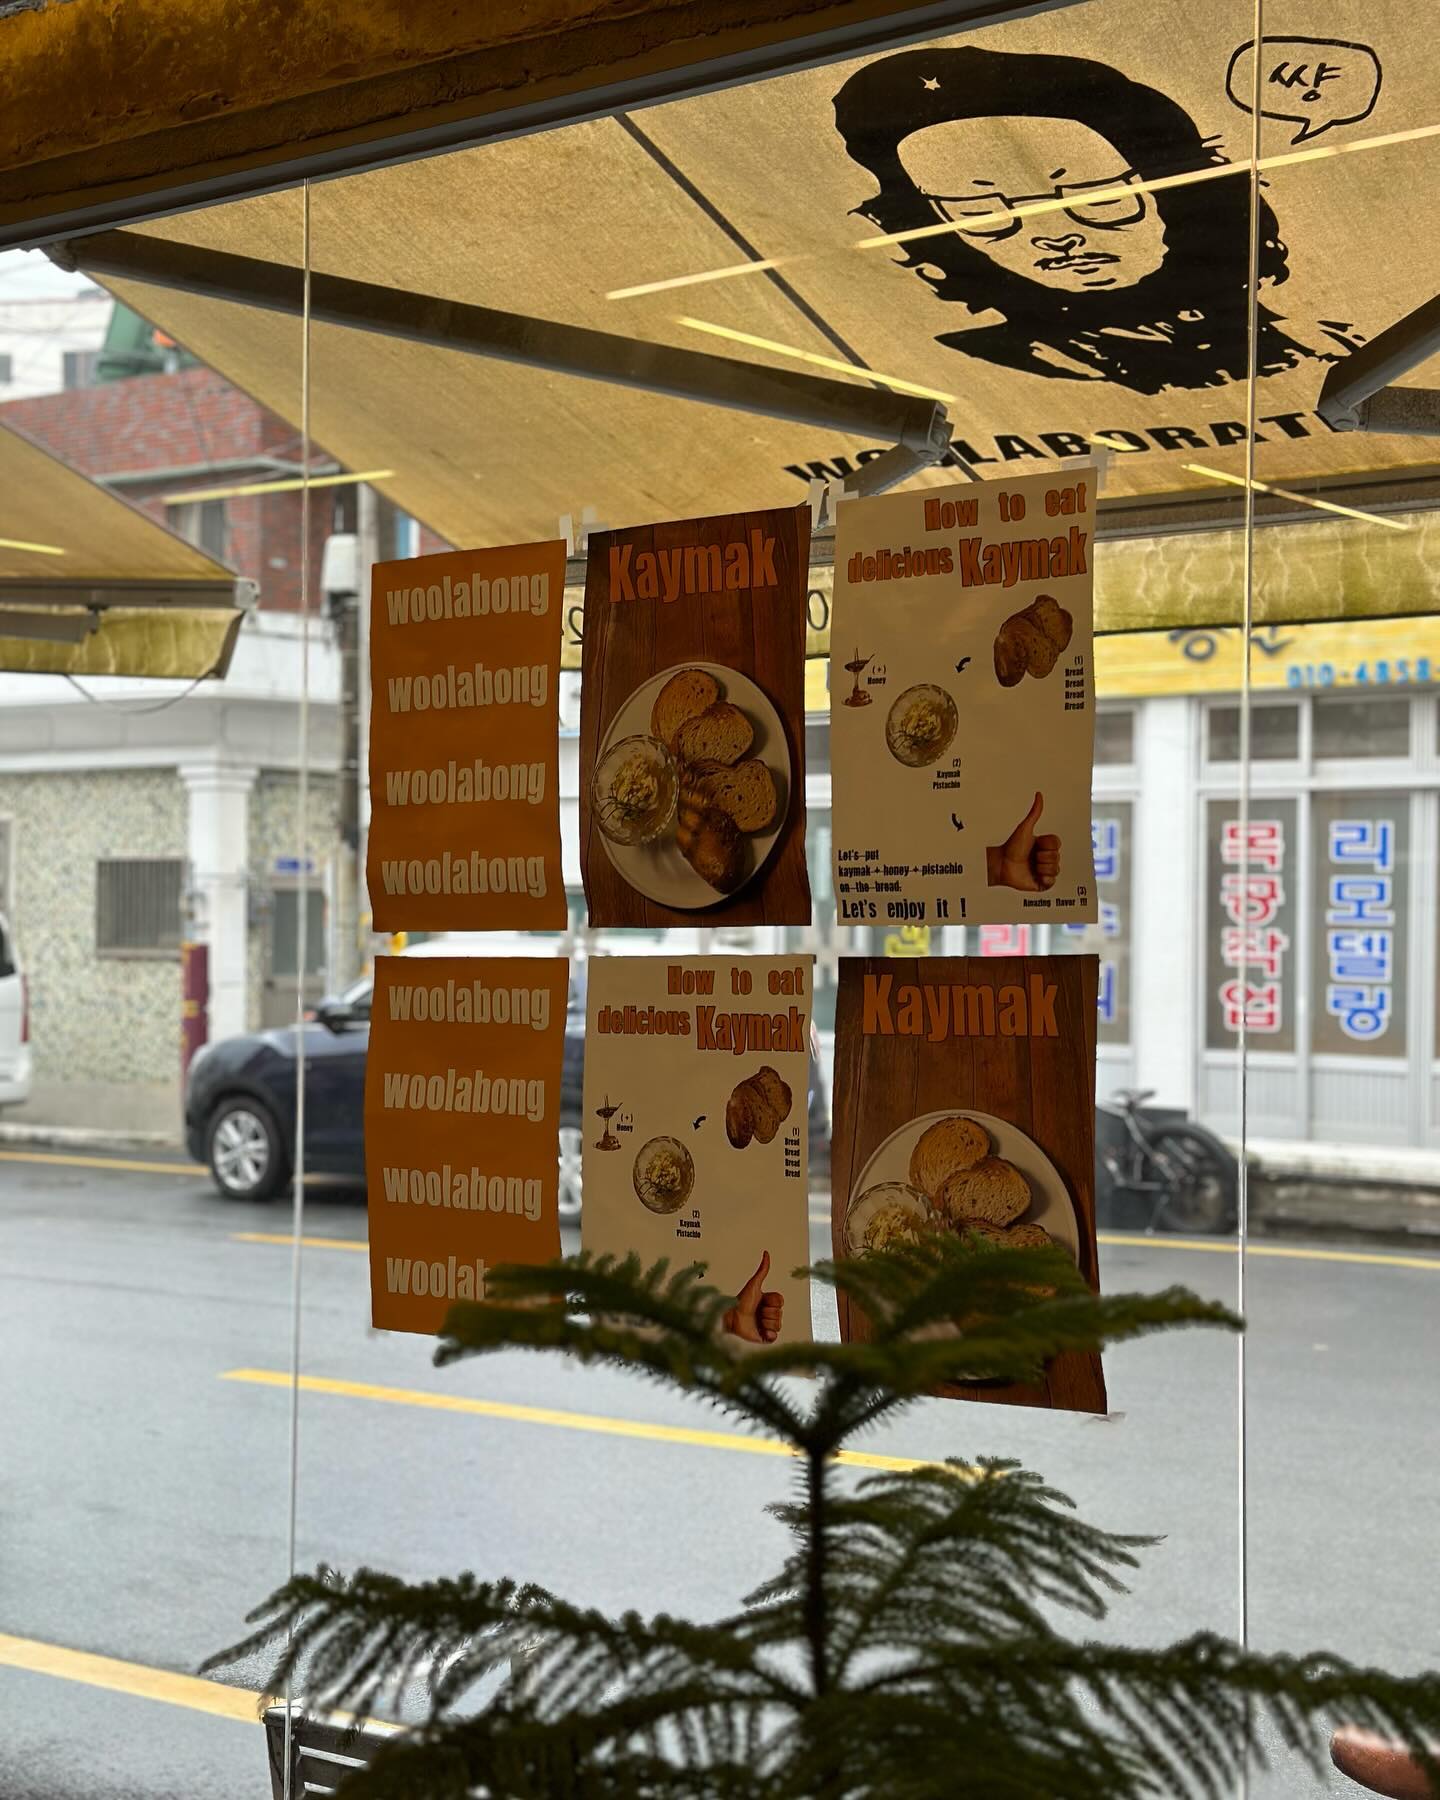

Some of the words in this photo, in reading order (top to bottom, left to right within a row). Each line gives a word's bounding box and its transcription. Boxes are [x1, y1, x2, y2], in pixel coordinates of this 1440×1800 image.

[924, 498, 979, 532] How
[998, 491, 1026, 522] to
[1045, 482, 1087, 517] eat
[608, 528, 778, 604] Kaymak
[848, 546, 953, 584] delicious
[959, 525, 1088, 588] Kaymak
[386, 572, 550, 626] woolabong
[387, 662, 549, 713] woolabong
[386, 758, 546, 807] woolabong
[381, 850, 548, 899] woolabong
[838, 865, 871, 878] kaymak
[883, 864, 910, 877] honey
[921, 862, 963, 876] pistachio
[865, 849, 879, 861] put
[842, 899, 877, 919] Let's
[887, 898, 926, 920] enjoy
[936, 898, 949, 918] it
[1328, 821, 1392, 1037] 리모델링
[389, 980, 550, 1031] woolabong
[667, 966, 715, 995] How
[731, 967, 752, 995] to
[767, 967, 804, 995] eat
[598, 1005, 691, 1035] delicious
[696, 1005, 805, 1055] Kaymak
[863, 973, 1060, 1043] Kaymak
[383, 1068, 545, 1122] woolabong
[383, 1164, 543, 1222] woolabong
[386, 1256, 490, 1300] woolab
